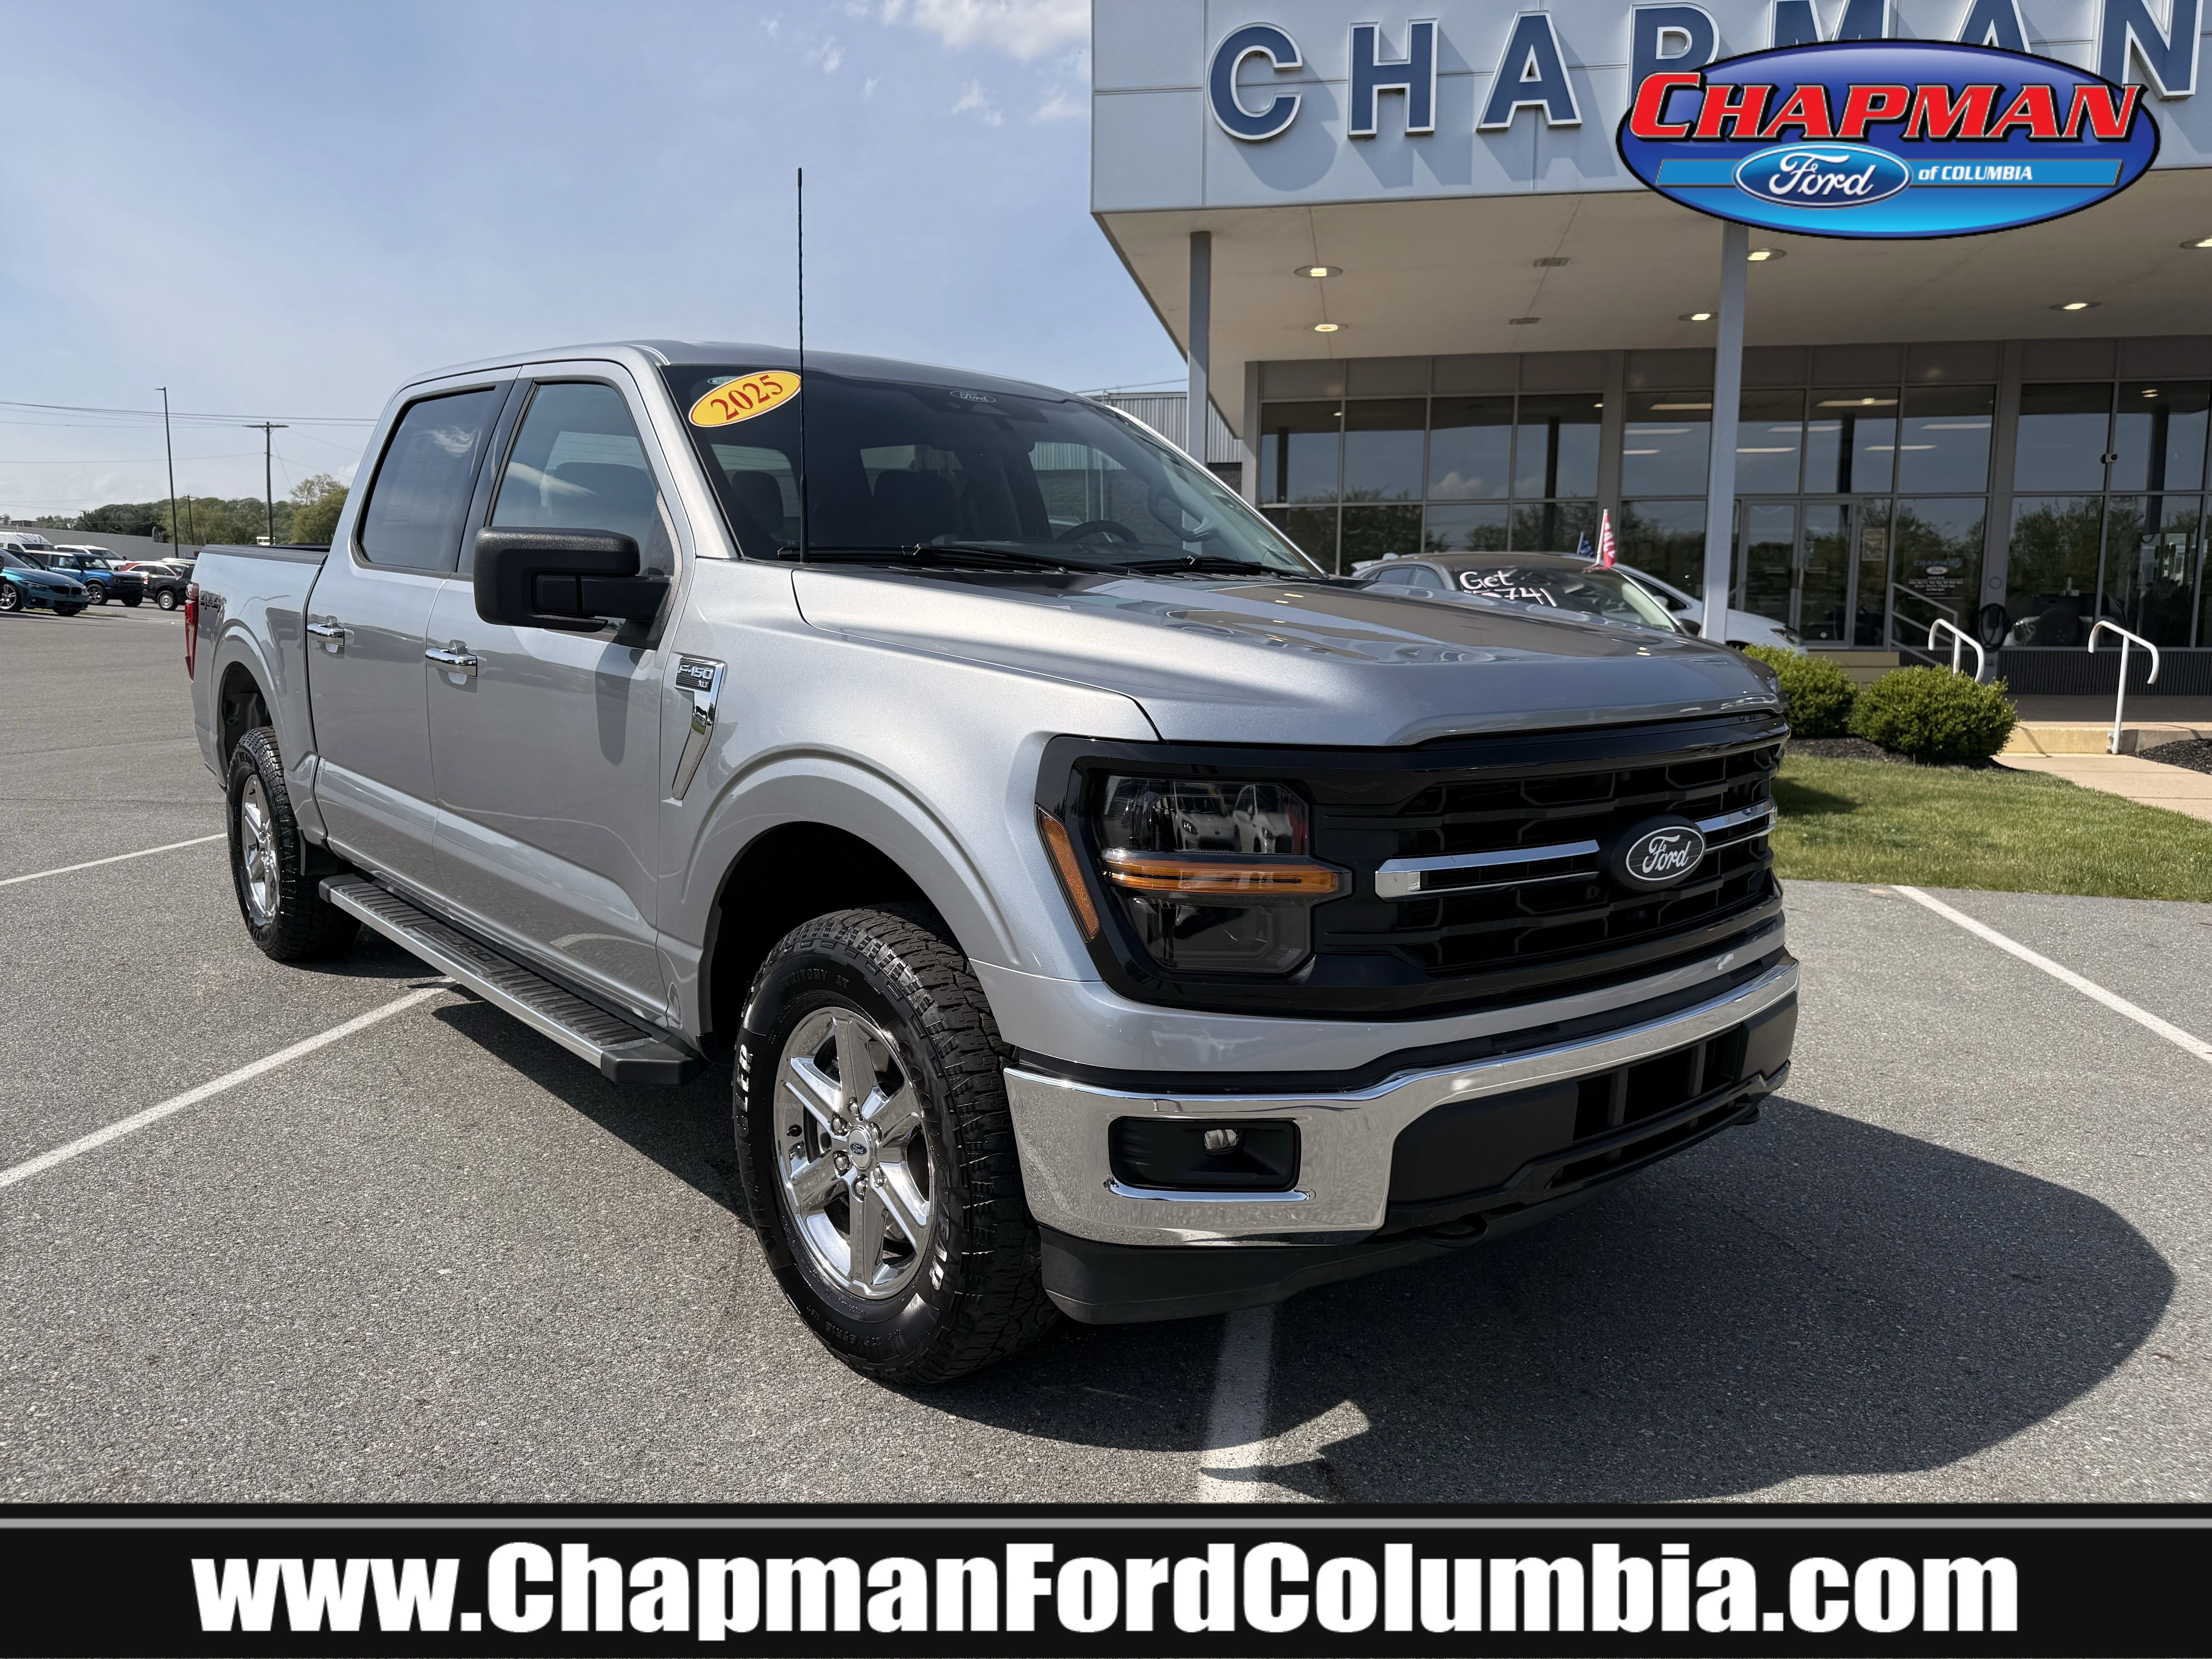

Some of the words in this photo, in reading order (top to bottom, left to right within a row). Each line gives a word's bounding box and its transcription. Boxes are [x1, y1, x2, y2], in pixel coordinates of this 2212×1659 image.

[710, 374, 783, 421] 2025
[960, 392, 989, 401] Ford
[1460, 568, 1518, 589] Get
[678, 664, 714, 680] F-150
[697, 680, 709, 688] XLT
[1642, 835, 1692, 874] Ford
[836, 975, 849, 989] AT
[852, 1144, 864, 1154] Ford
